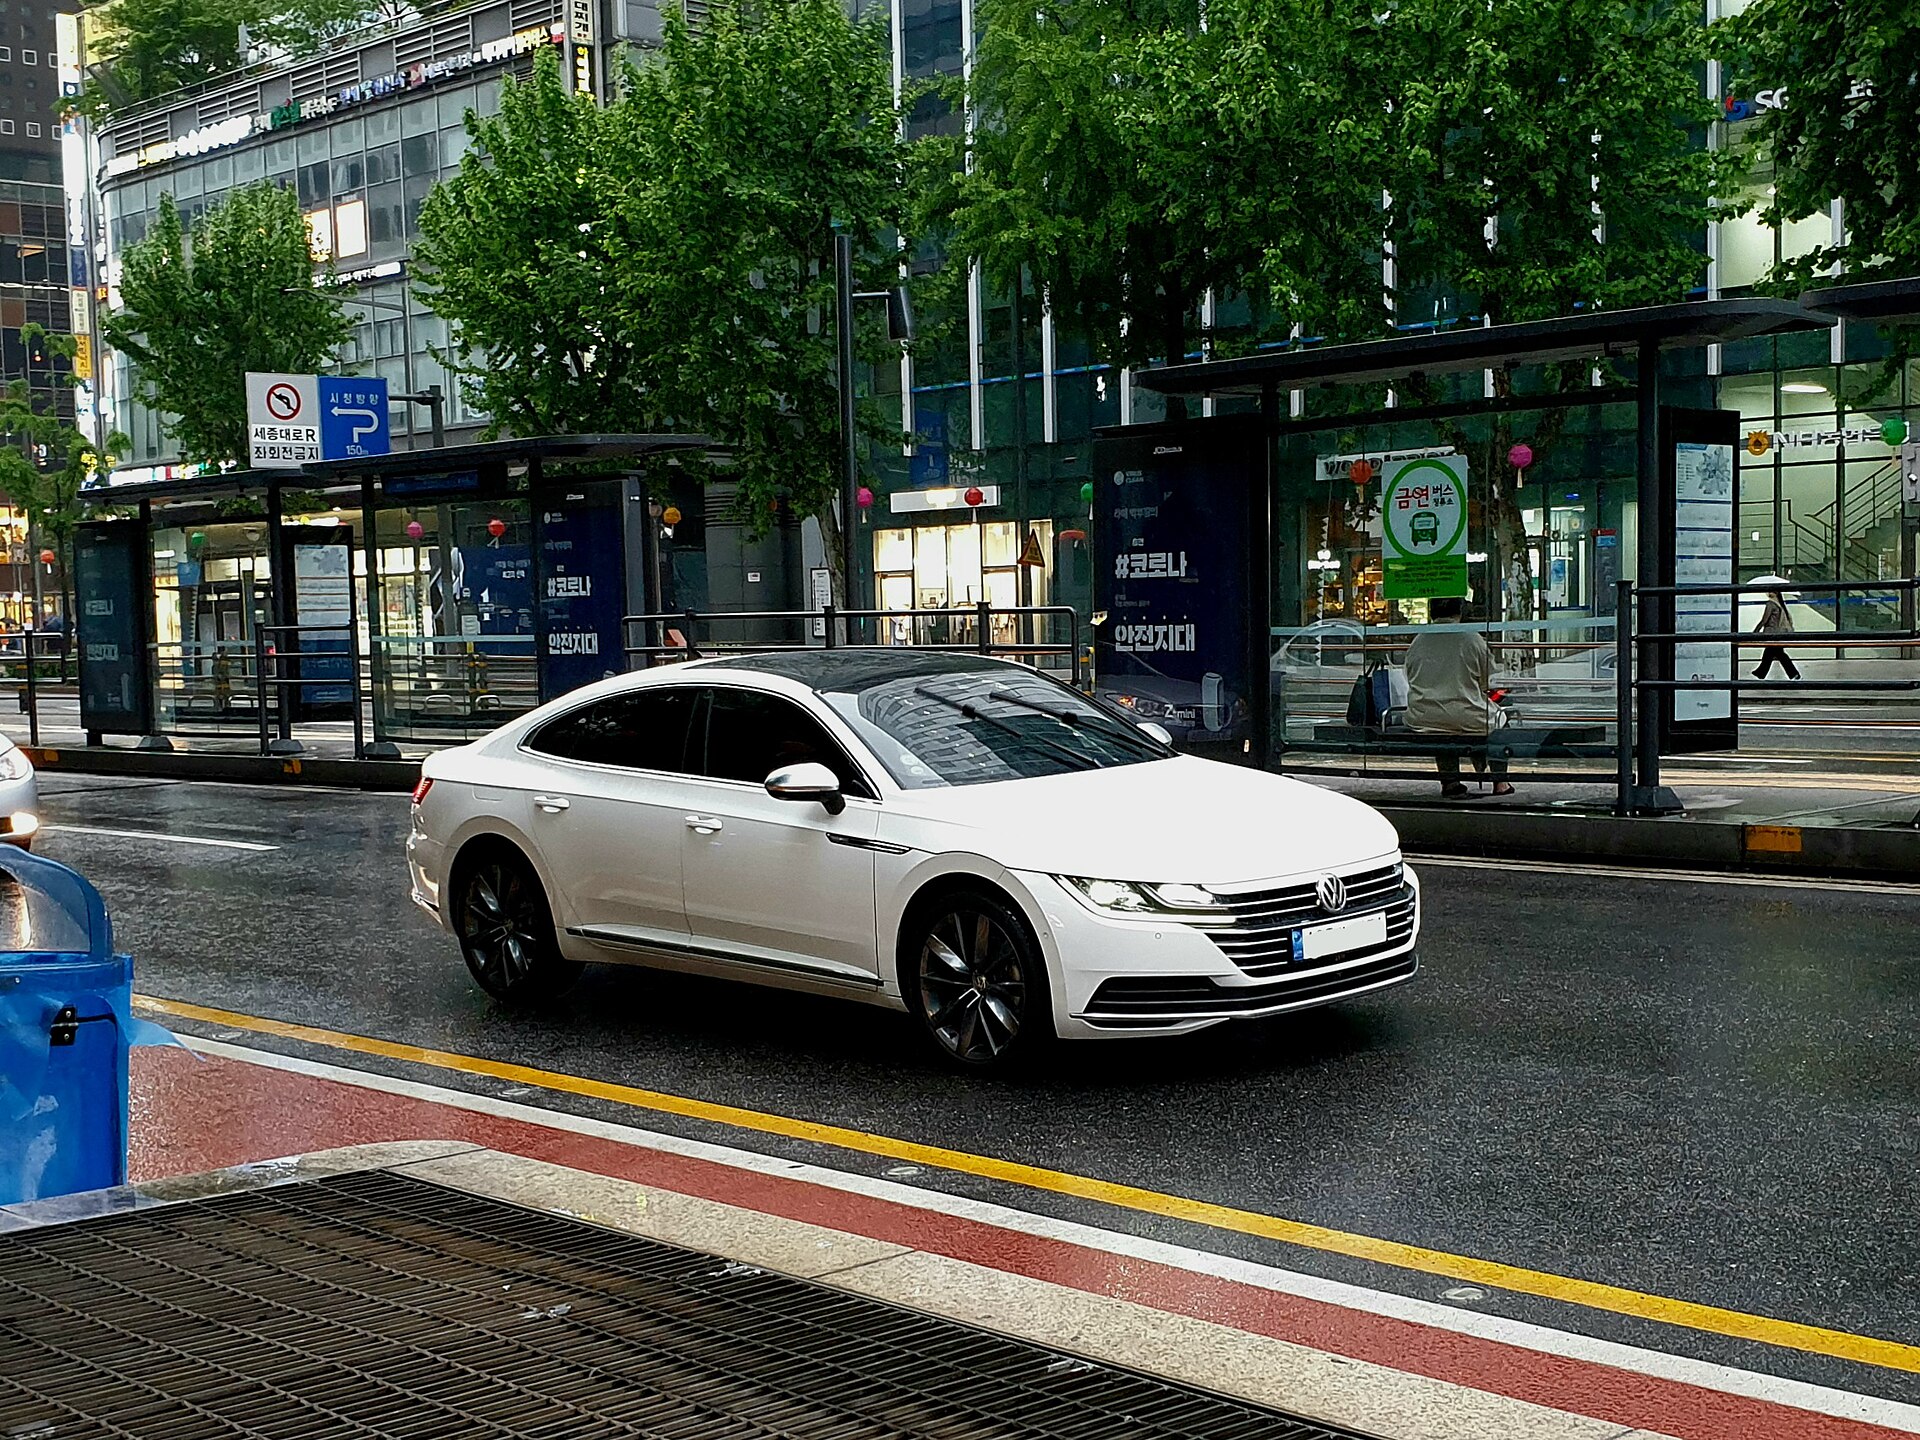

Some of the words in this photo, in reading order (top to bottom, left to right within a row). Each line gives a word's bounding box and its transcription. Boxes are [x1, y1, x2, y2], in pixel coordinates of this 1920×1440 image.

[330, 392, 379, 405] 시청방향
[254, 446, 319, 460] 좌회전금지
[1394, 484, 1429, 509] 금연
[1432, 483, 1454, 496] 버스
[1433, 497, 1454, 507] 정류소
[1115, 551, 1188, 578] #코로나
[547, 575, 592, 597] #코로나
[549, 633, 599, 655] 안전지대
[1115, 624, 1195, 652] 안전지대
